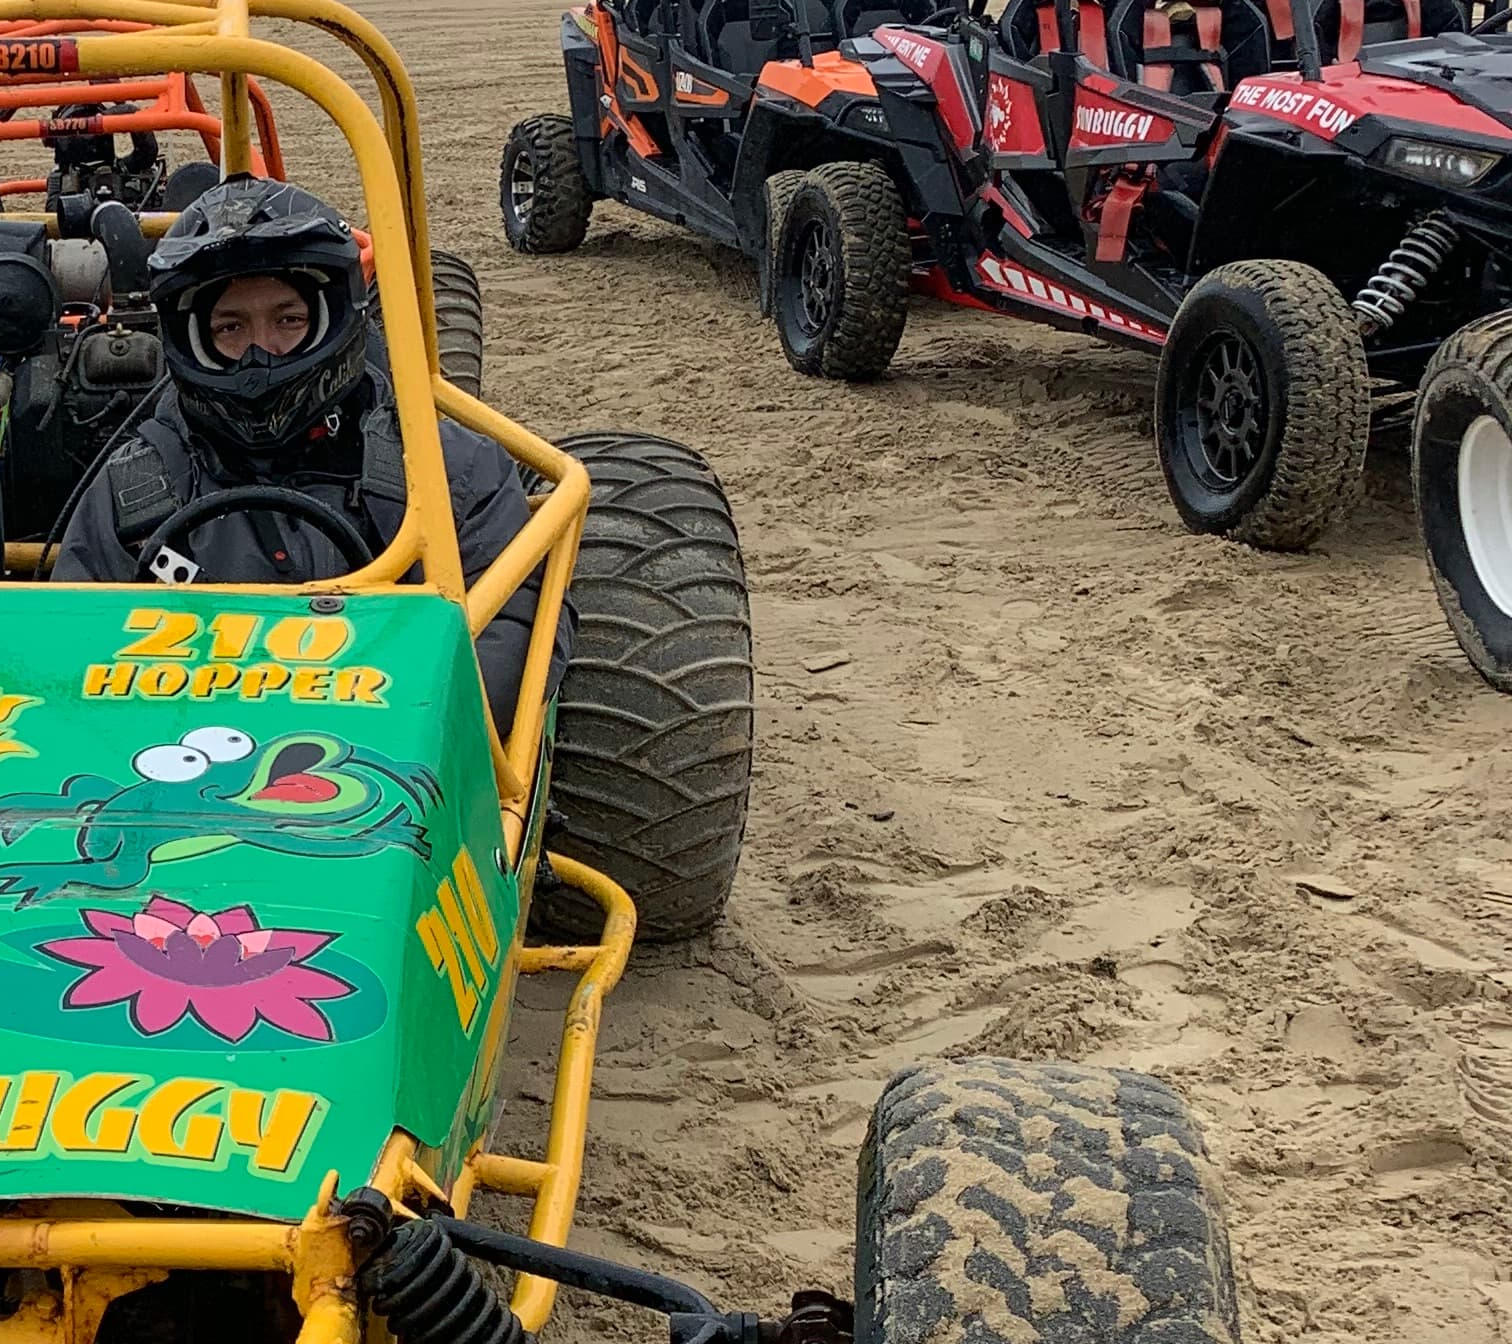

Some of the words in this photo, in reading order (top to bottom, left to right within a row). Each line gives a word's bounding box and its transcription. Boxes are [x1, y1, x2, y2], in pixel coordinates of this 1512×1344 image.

[1076, 105, 1154, 140] SUNBUGGY
[1232, 85, 1267, 106] THE
[1259, 88, 1314, 115] MOST
[1305, 98, 1356, 133] FUN
[117, 608, 350, 660] 210
[84, 662, 389, 704] HOPPER
[415, 844, 500, 1036] 210
